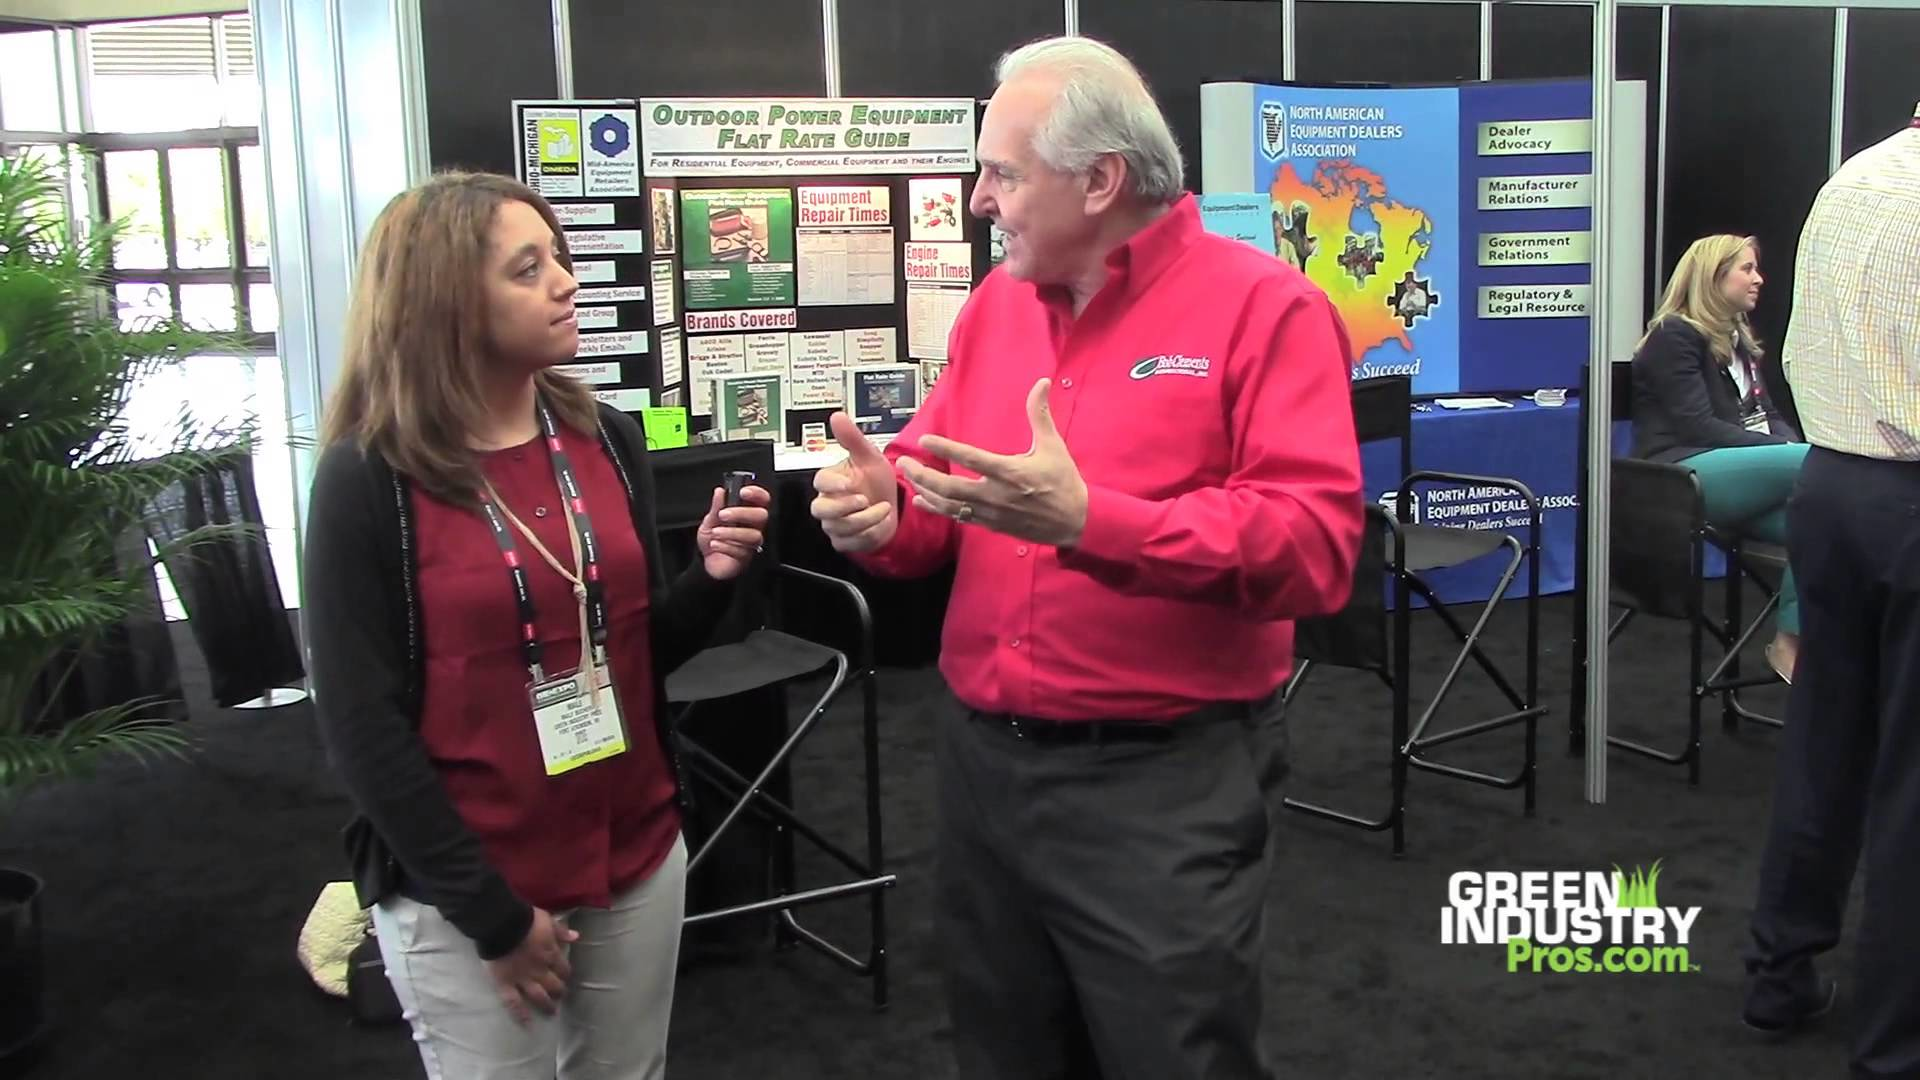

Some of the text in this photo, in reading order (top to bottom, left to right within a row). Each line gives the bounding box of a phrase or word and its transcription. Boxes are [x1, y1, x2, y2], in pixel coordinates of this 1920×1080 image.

[652, 104, 967, 126] OUTDOOR POWER EQUIPMENT
[1290, 106, 1384, 120] NORTH AMERICAN
[717, 127, 910, 149] FLAT RATE GUIDE
[1290, 124, 1403, 139] EQUIPMENT DEALERS
[1488, 126, 1531, 137] Dealer
[1290, 142, 1356, 157] ASSOCIATION
[1488, 139, 1552, 151] Advocacy
[650, 158, 669, 167] FOR
[672, 158, 727, 167] RESIDENTIAL
[731, 158, 783, 168] EQUIPMENT,
[786, 157, 840, 167] COMMERCIAL
[843, 156, 890, 166] EQUIPMENT
[936, 155, 971, 165] ENGINES
[590, 169, 632, 177] Equipment
[1488, 180, 1578, 192] Manufacturer
[801, 190, 872, 207] Equipment
[1488, 194, 1550, 204] Relations
[801, 207, 888, 225] Repair Times
[570, 243, 624, 252] epresentation
[1488, 237, 1571, 247] Government
[906, 245, 938, 262] Engine
[1488, 250, 1549, 260] Relations
[906, 262, 970, 280] Repair Times
[574, 288, 641, 299] ccounting Service
[1488, 288, 1574, 303] Regulatory &
[1488, 302, 1585, 315] Legal Resource
[687, 310, 795, 330] Brands Covered
[579, 335, 616, 343] wsletters
[579, 343, 626, 353] eekly Emails
[1362, 357, 1422, 379] Succeed
[1427, 490, 1465, 503] NORTH
[1427, 502, 1491, 519] EQUIPMENT
[1492, 498, 1541, 513] DEALE
[1467, 519, 1503, 531] Dealers
[1505, 514, 1543, 528] Succe
